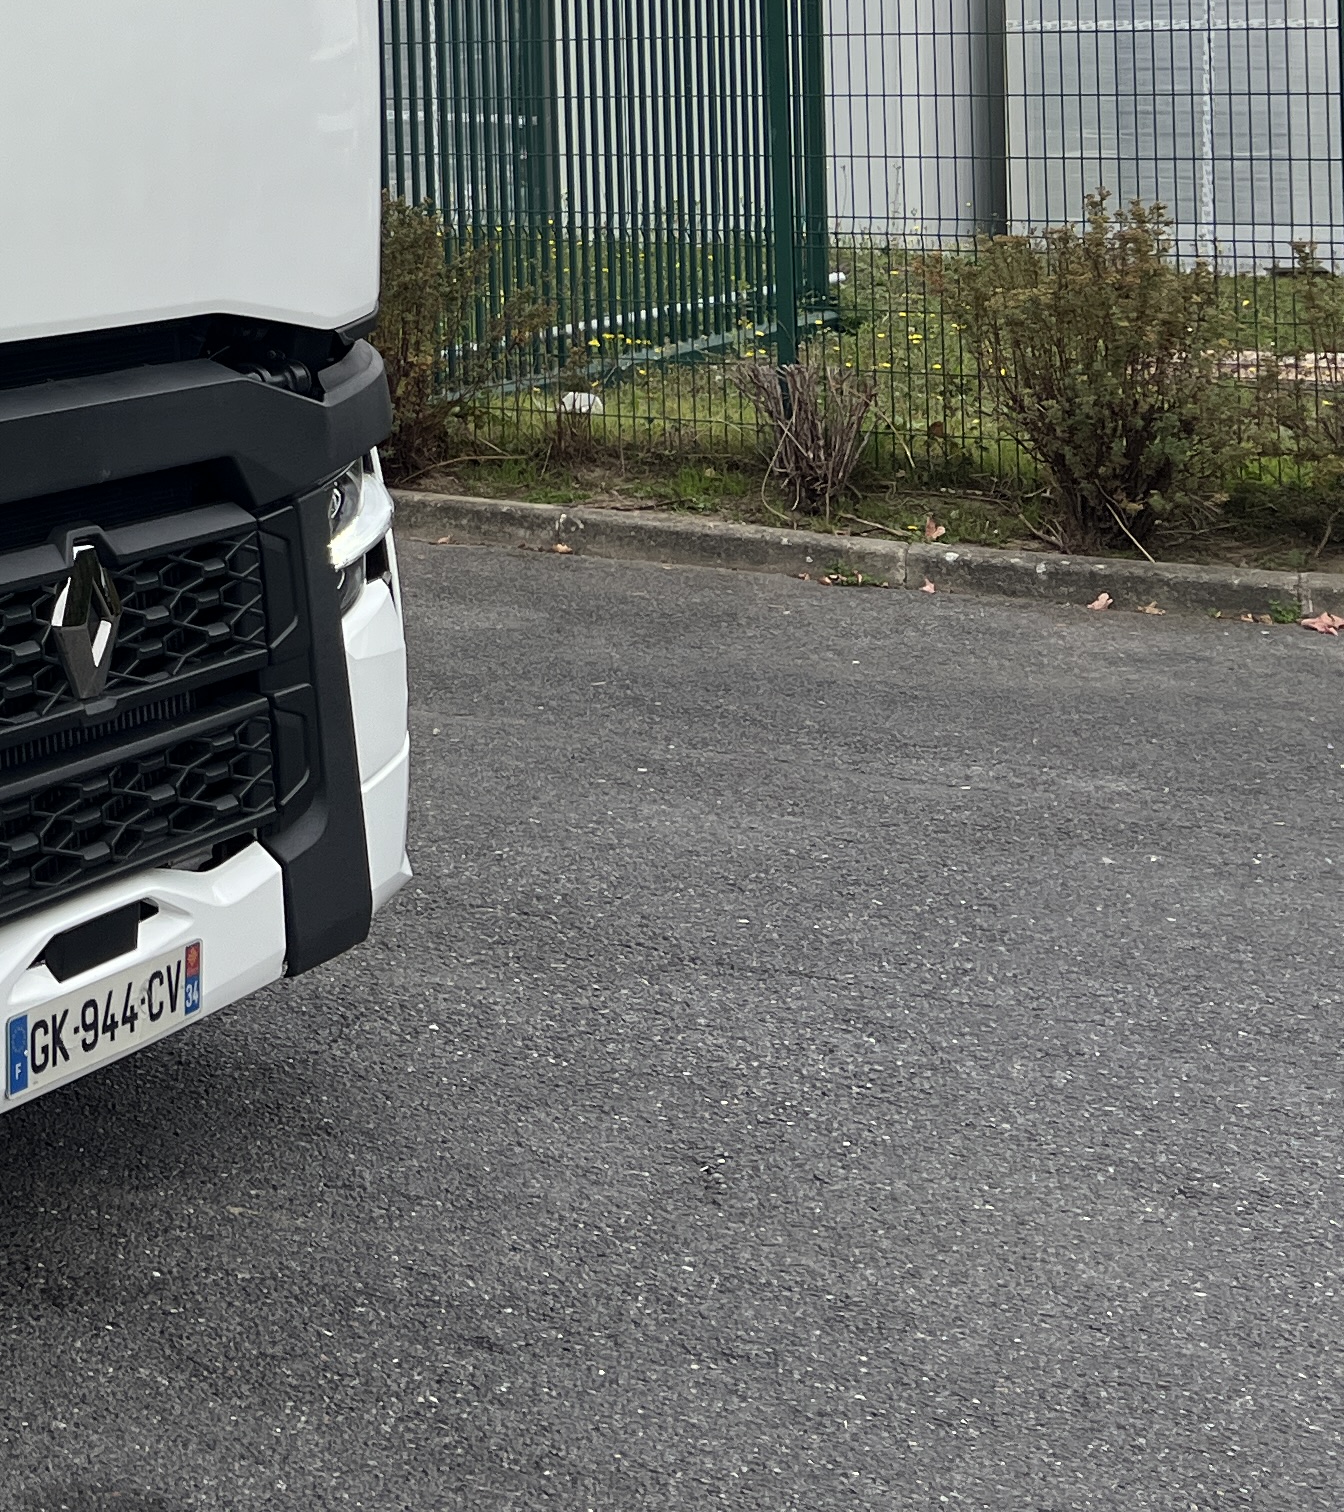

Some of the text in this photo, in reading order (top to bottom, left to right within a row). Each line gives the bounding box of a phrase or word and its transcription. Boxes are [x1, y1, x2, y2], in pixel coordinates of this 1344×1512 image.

[14, 960, 199, 1081] F GK-944-CV 34
